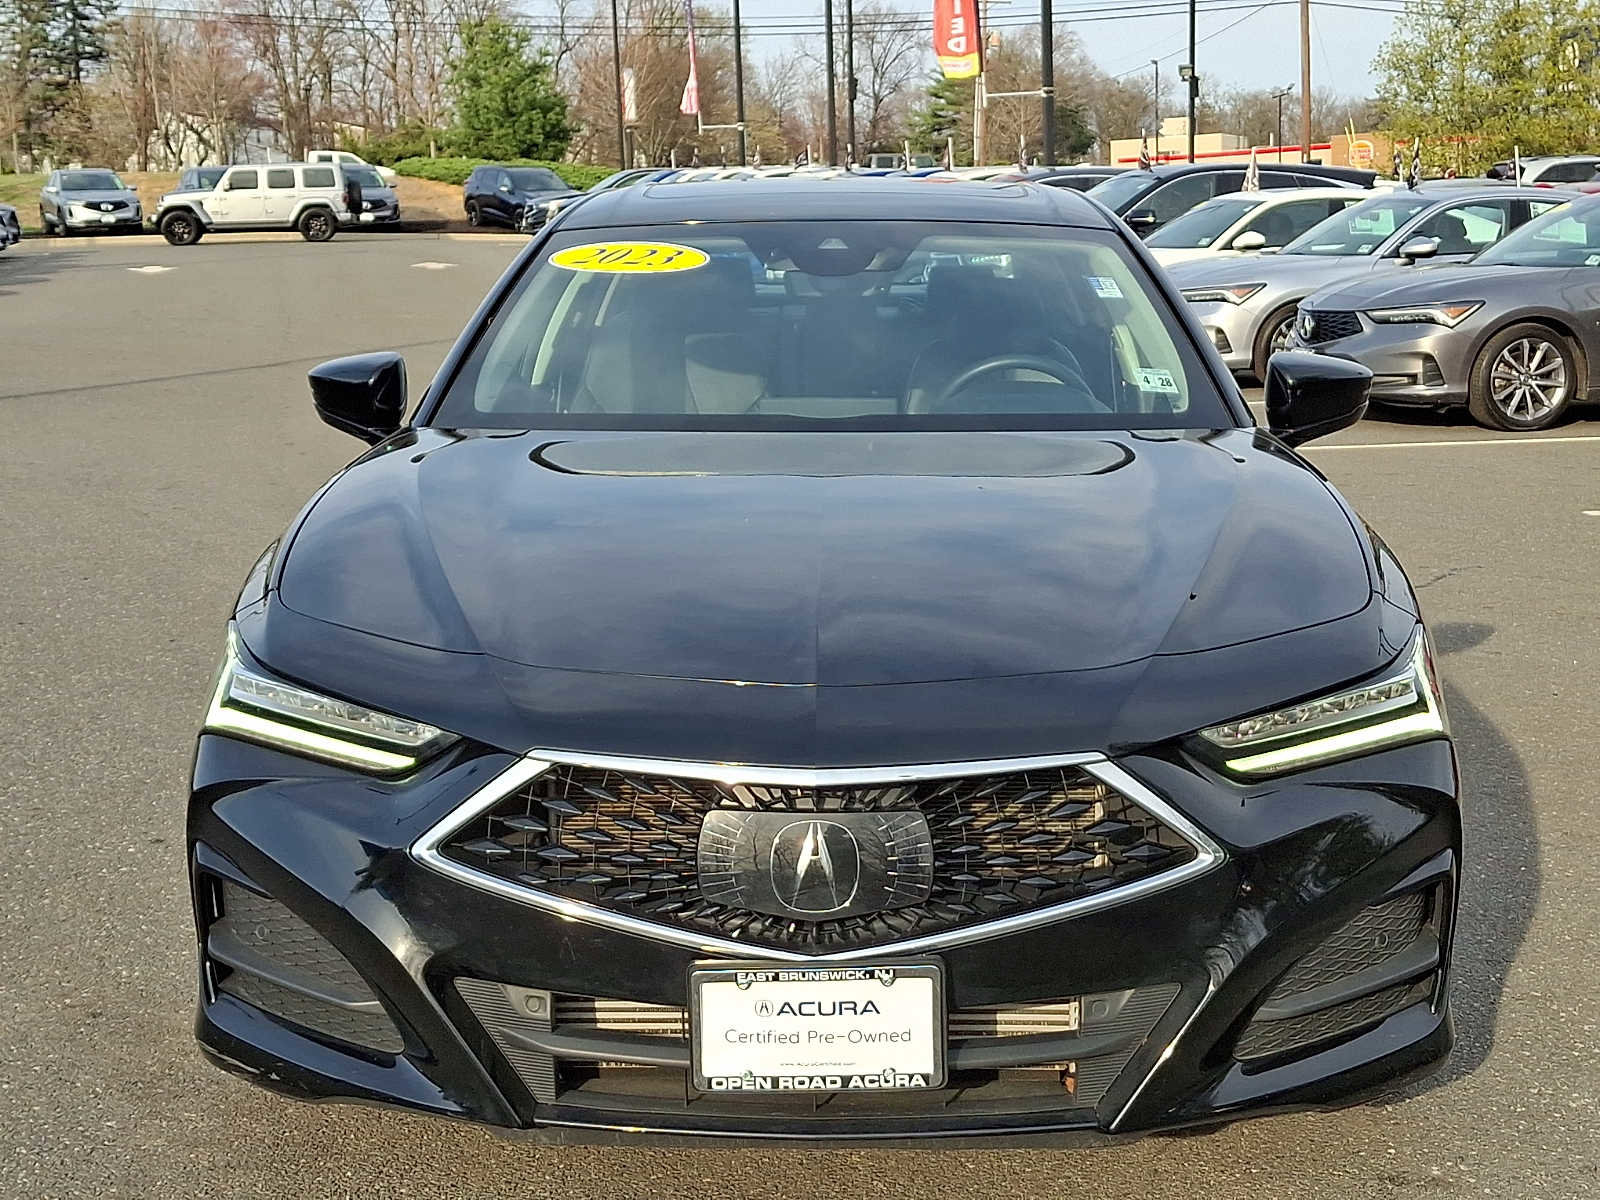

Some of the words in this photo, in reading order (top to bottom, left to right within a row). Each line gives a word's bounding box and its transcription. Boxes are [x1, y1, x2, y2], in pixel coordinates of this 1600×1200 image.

[572, 248, 684, 266] 2023
[1143, 375, 1150, 385] 4
[1158, 377, 1172, 387] 28
[736, 972, 775, 982] EAST
[777, 1000, 881, 1017] ACURA
[724, 1028, 800, 1044] Certified
[807, 1028, 912, 1044] Pre-Owned
[711, 1076, 772, 1090] OPEN
[778, 1076, 842, 1089] ROAD
[848, 1074, 927, 1088] ACURA
